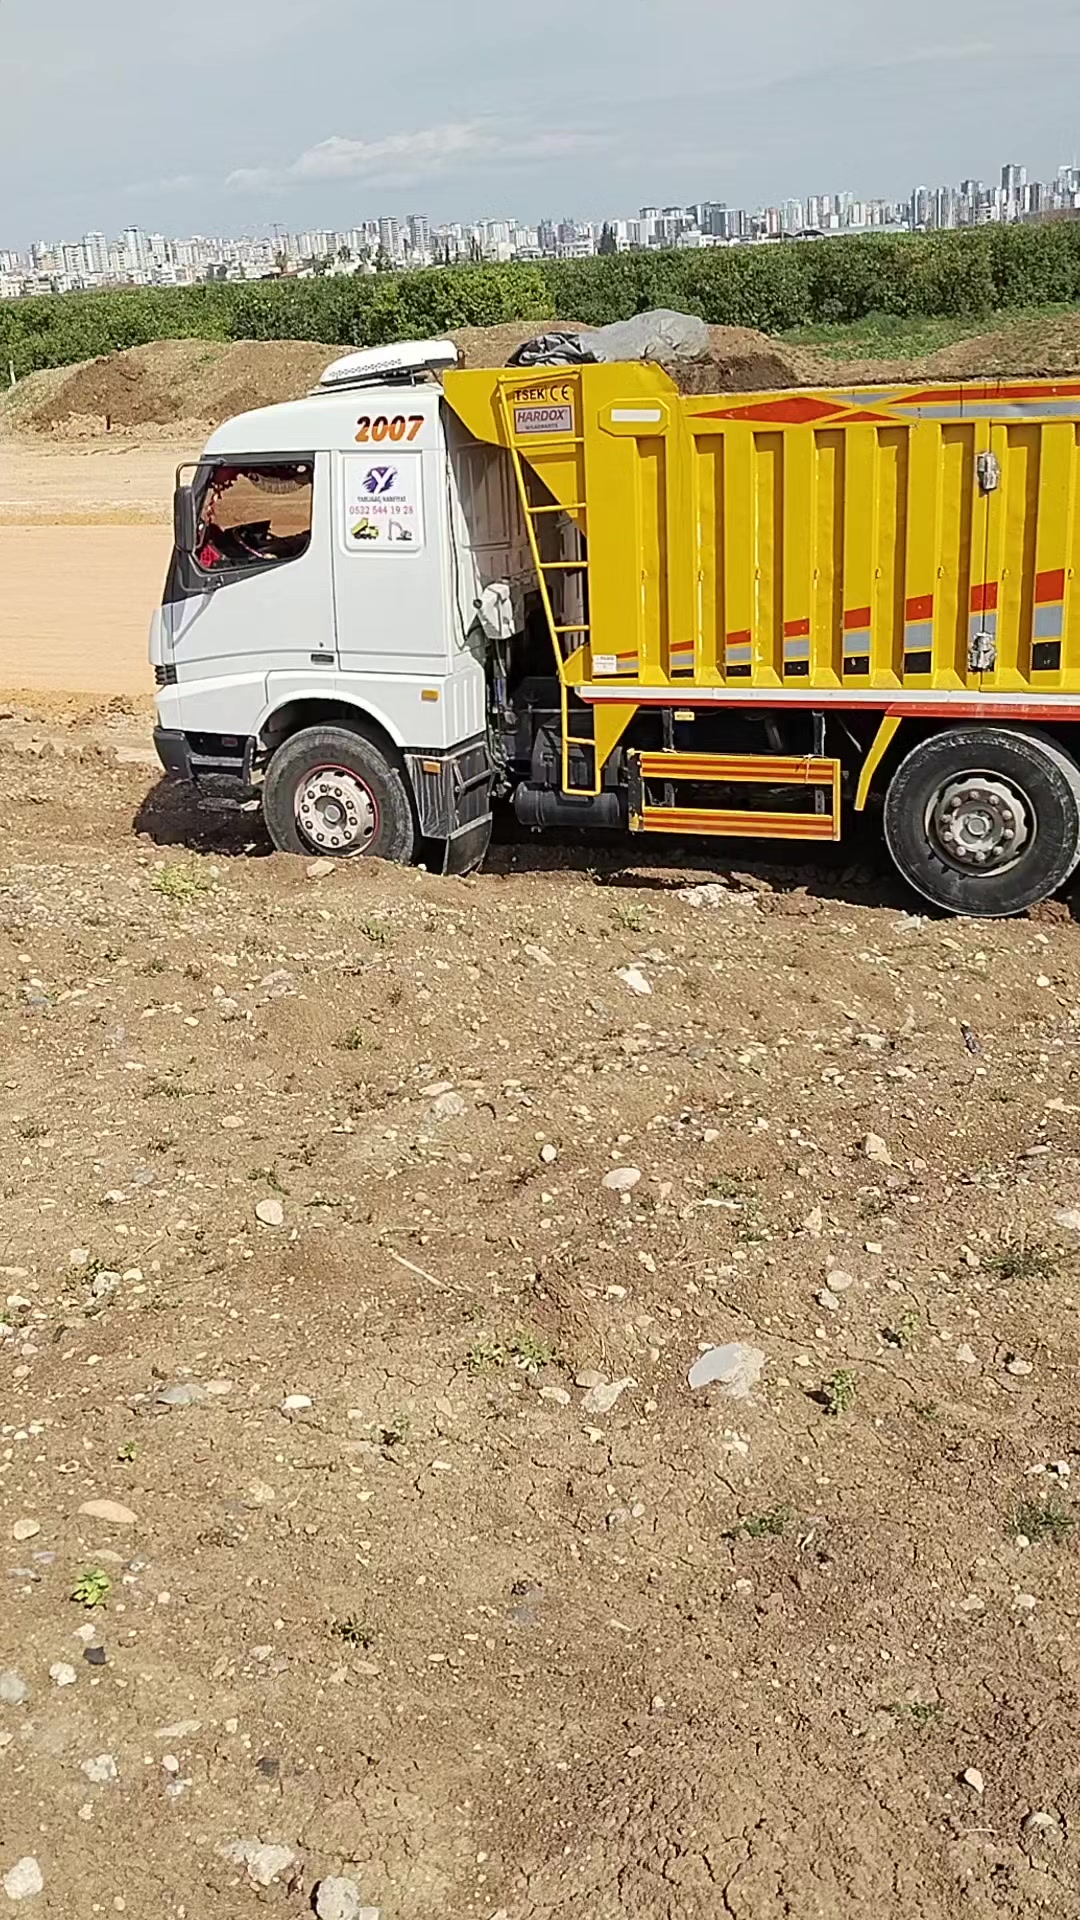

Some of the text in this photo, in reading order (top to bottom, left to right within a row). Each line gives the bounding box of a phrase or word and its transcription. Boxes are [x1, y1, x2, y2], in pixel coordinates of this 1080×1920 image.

[514, 388, 545, 401] TSEK
[517, 409, 564, 423] HARDOX
[355, 414, 425, 442] 2007
[349, 505, 370, 515] 0532
[372, 505, 388, 515] 544
[391, 505, 401, 515] 19
